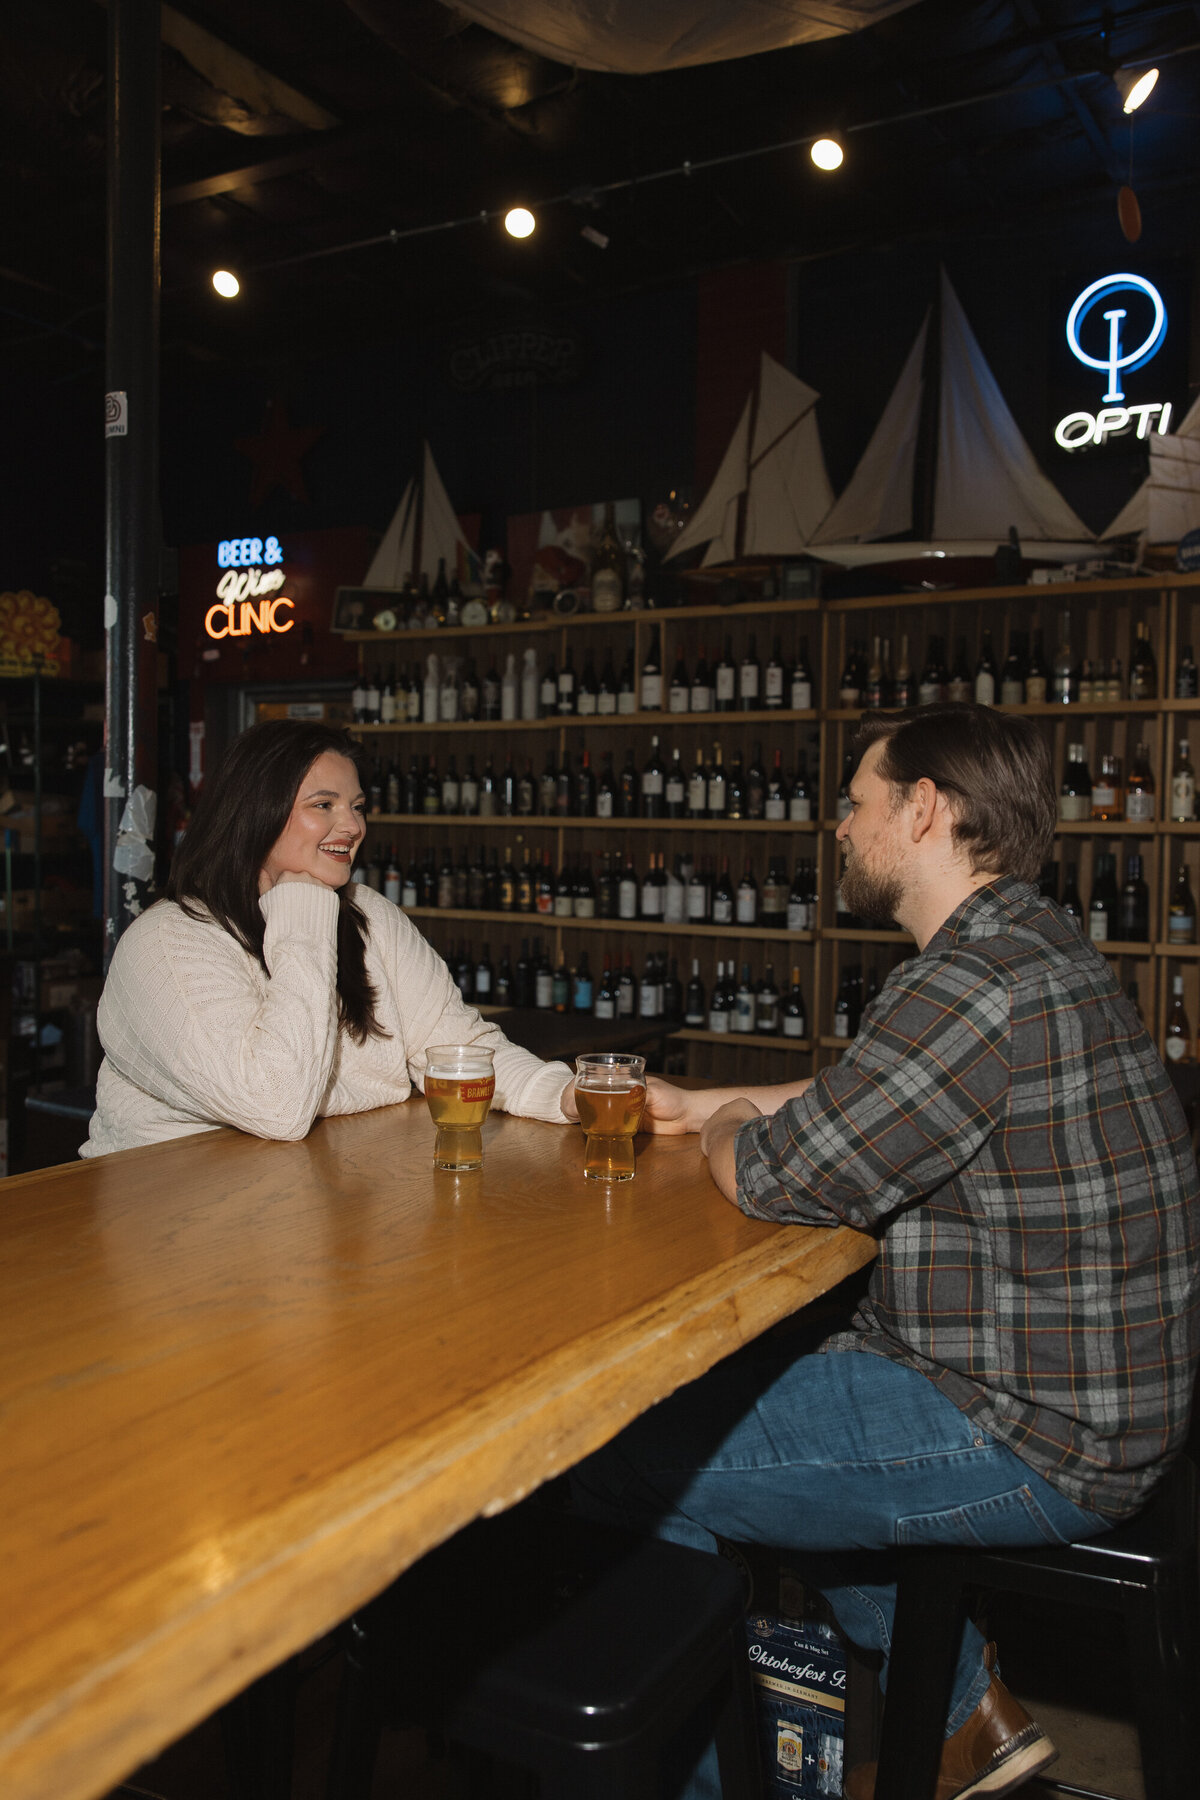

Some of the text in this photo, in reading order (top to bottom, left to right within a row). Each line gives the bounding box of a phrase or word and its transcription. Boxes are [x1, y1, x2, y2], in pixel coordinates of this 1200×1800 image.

[450, 331, 577, 383] CLIPPER
[217, 535, 285, 568] BEER &
[204, 597, 296, 640] CLINIC
[748, 1644, 826, 1682] Oktoberfest
[794, 1640, 804, 1649] Can
[809, 1645, 821, 1654] Mug
[762, 1678, 783, 1688] BREWED
[793, 1688, 818, 1699] GERMANY
